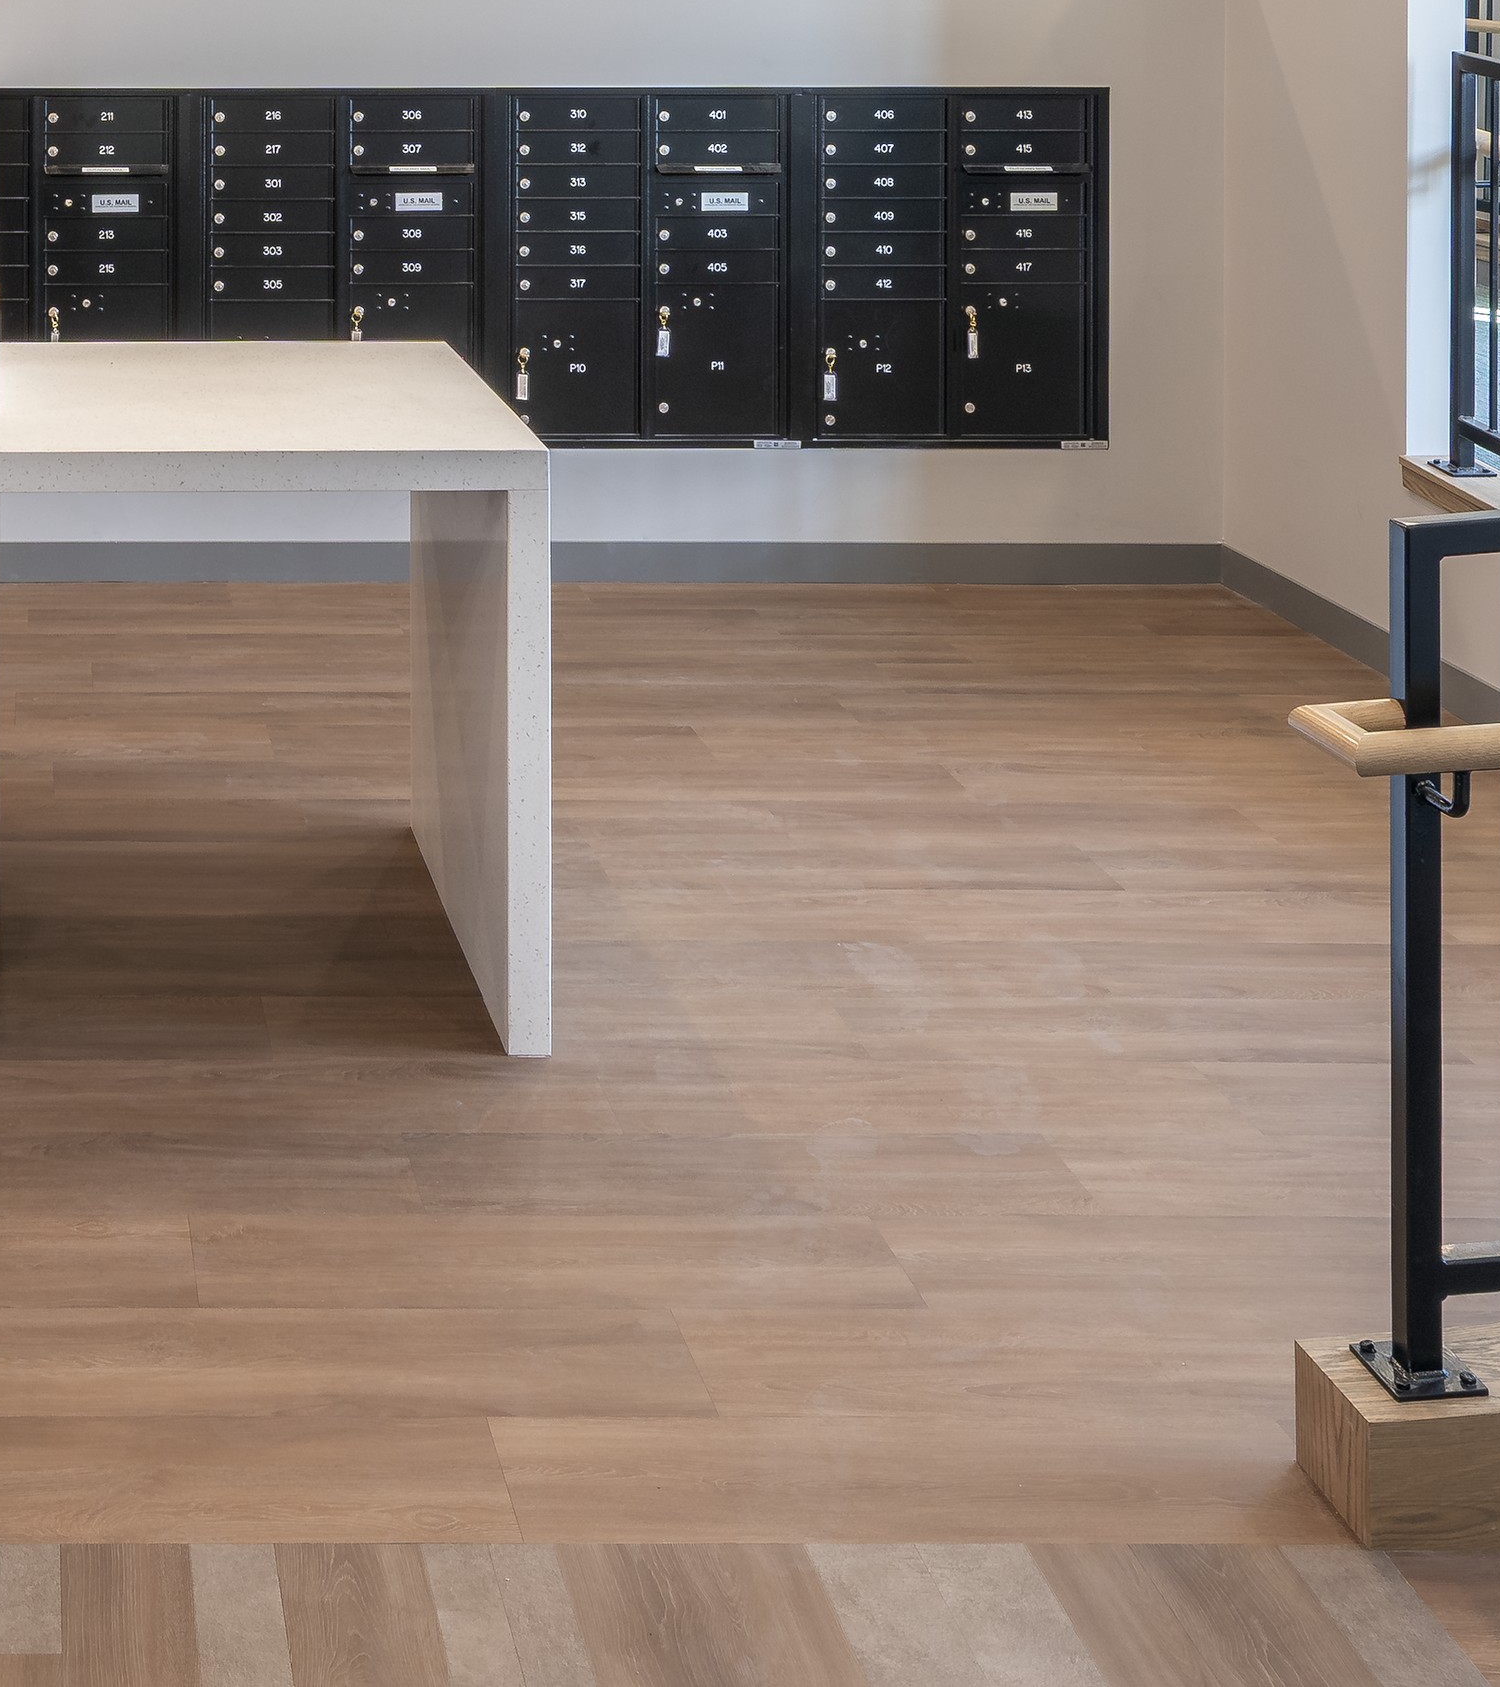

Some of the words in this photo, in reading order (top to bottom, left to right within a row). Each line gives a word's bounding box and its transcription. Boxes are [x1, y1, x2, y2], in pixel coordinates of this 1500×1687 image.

[100, 111, 114, 122] 211
[265, 110, 282, 121] 216
[401, 109, 422, 120] 306
[569, 108, 588, 119] 310
[708, 109, 727, 120] 401
[873, 109, 895, 120] 406
[1015, 109, 1034, 120] 413
[98, 144, 115, 156] 212
[265, 144, 282, 155] 217
[401, 143, 423, 154] 307
[570, 142, 587, 153] 312
[707, 143, 728, 154] 402
[873, 143, 895, 154] 407
[1015, 143, 1033, 154] 415
[264, 178, 282, 189] 301
[569, 177, 587, 188] 313
[873, 177, 895, 188] 408
[262, 212, 283, 223] 302
[569, 210, 587, 222] 315
[873, 211, 895, 221] 409
[98, 229, 115, 240] 213
[401, 228, 423, 239] 308
[706, 228, 728, 239] 403
[1015, 228, 1033, 238] 416
[262, 245, 283, 256] 303
[569, 244, 587, 255] 316
[875, 244, 893, 255] 410
[98, 263, 115, 274] 215
[401, 262, 422, 273] 309
[706, 262, 728, 273] 405
[1015, 261, 1033, 272] 417
[262, 279, 284, 290] 305
[569, 278, 587, 289] 317
[875, 278, 893, 289] 412
[569, 363, 587, 374] P10
[710, 360, 725, 371] P11
[875, 363, 892, 374] P12
[1015, 363, 1032, 374] P13
